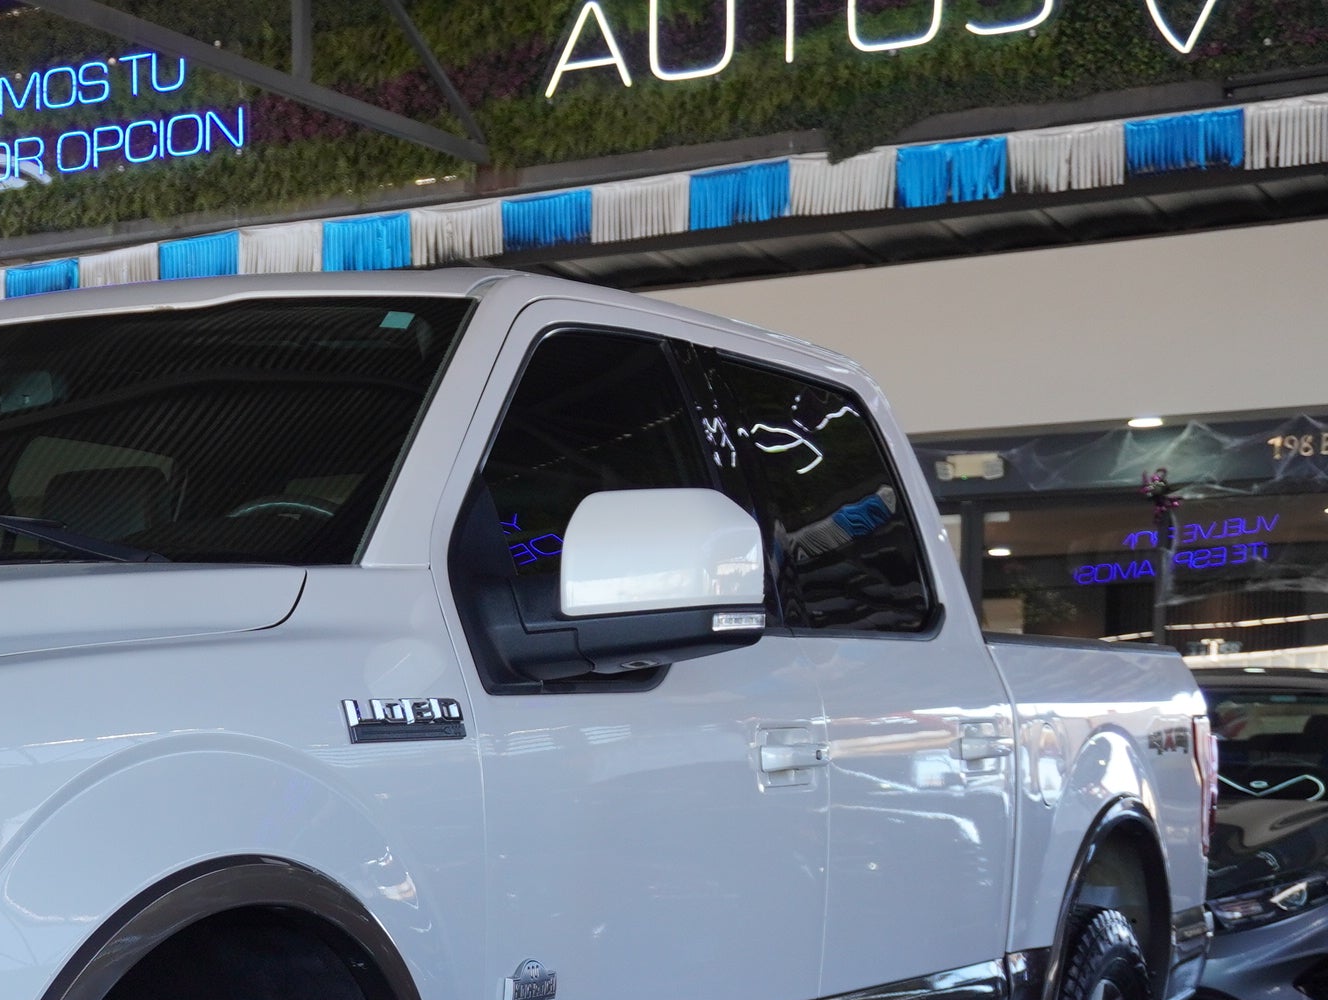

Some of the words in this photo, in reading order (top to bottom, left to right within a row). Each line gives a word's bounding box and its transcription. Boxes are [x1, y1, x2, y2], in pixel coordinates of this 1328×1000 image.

[118, 52, 186, 98] TU
[56, 106, 245, 174] OPCION
[341, 697, 464, 727] LOBO
